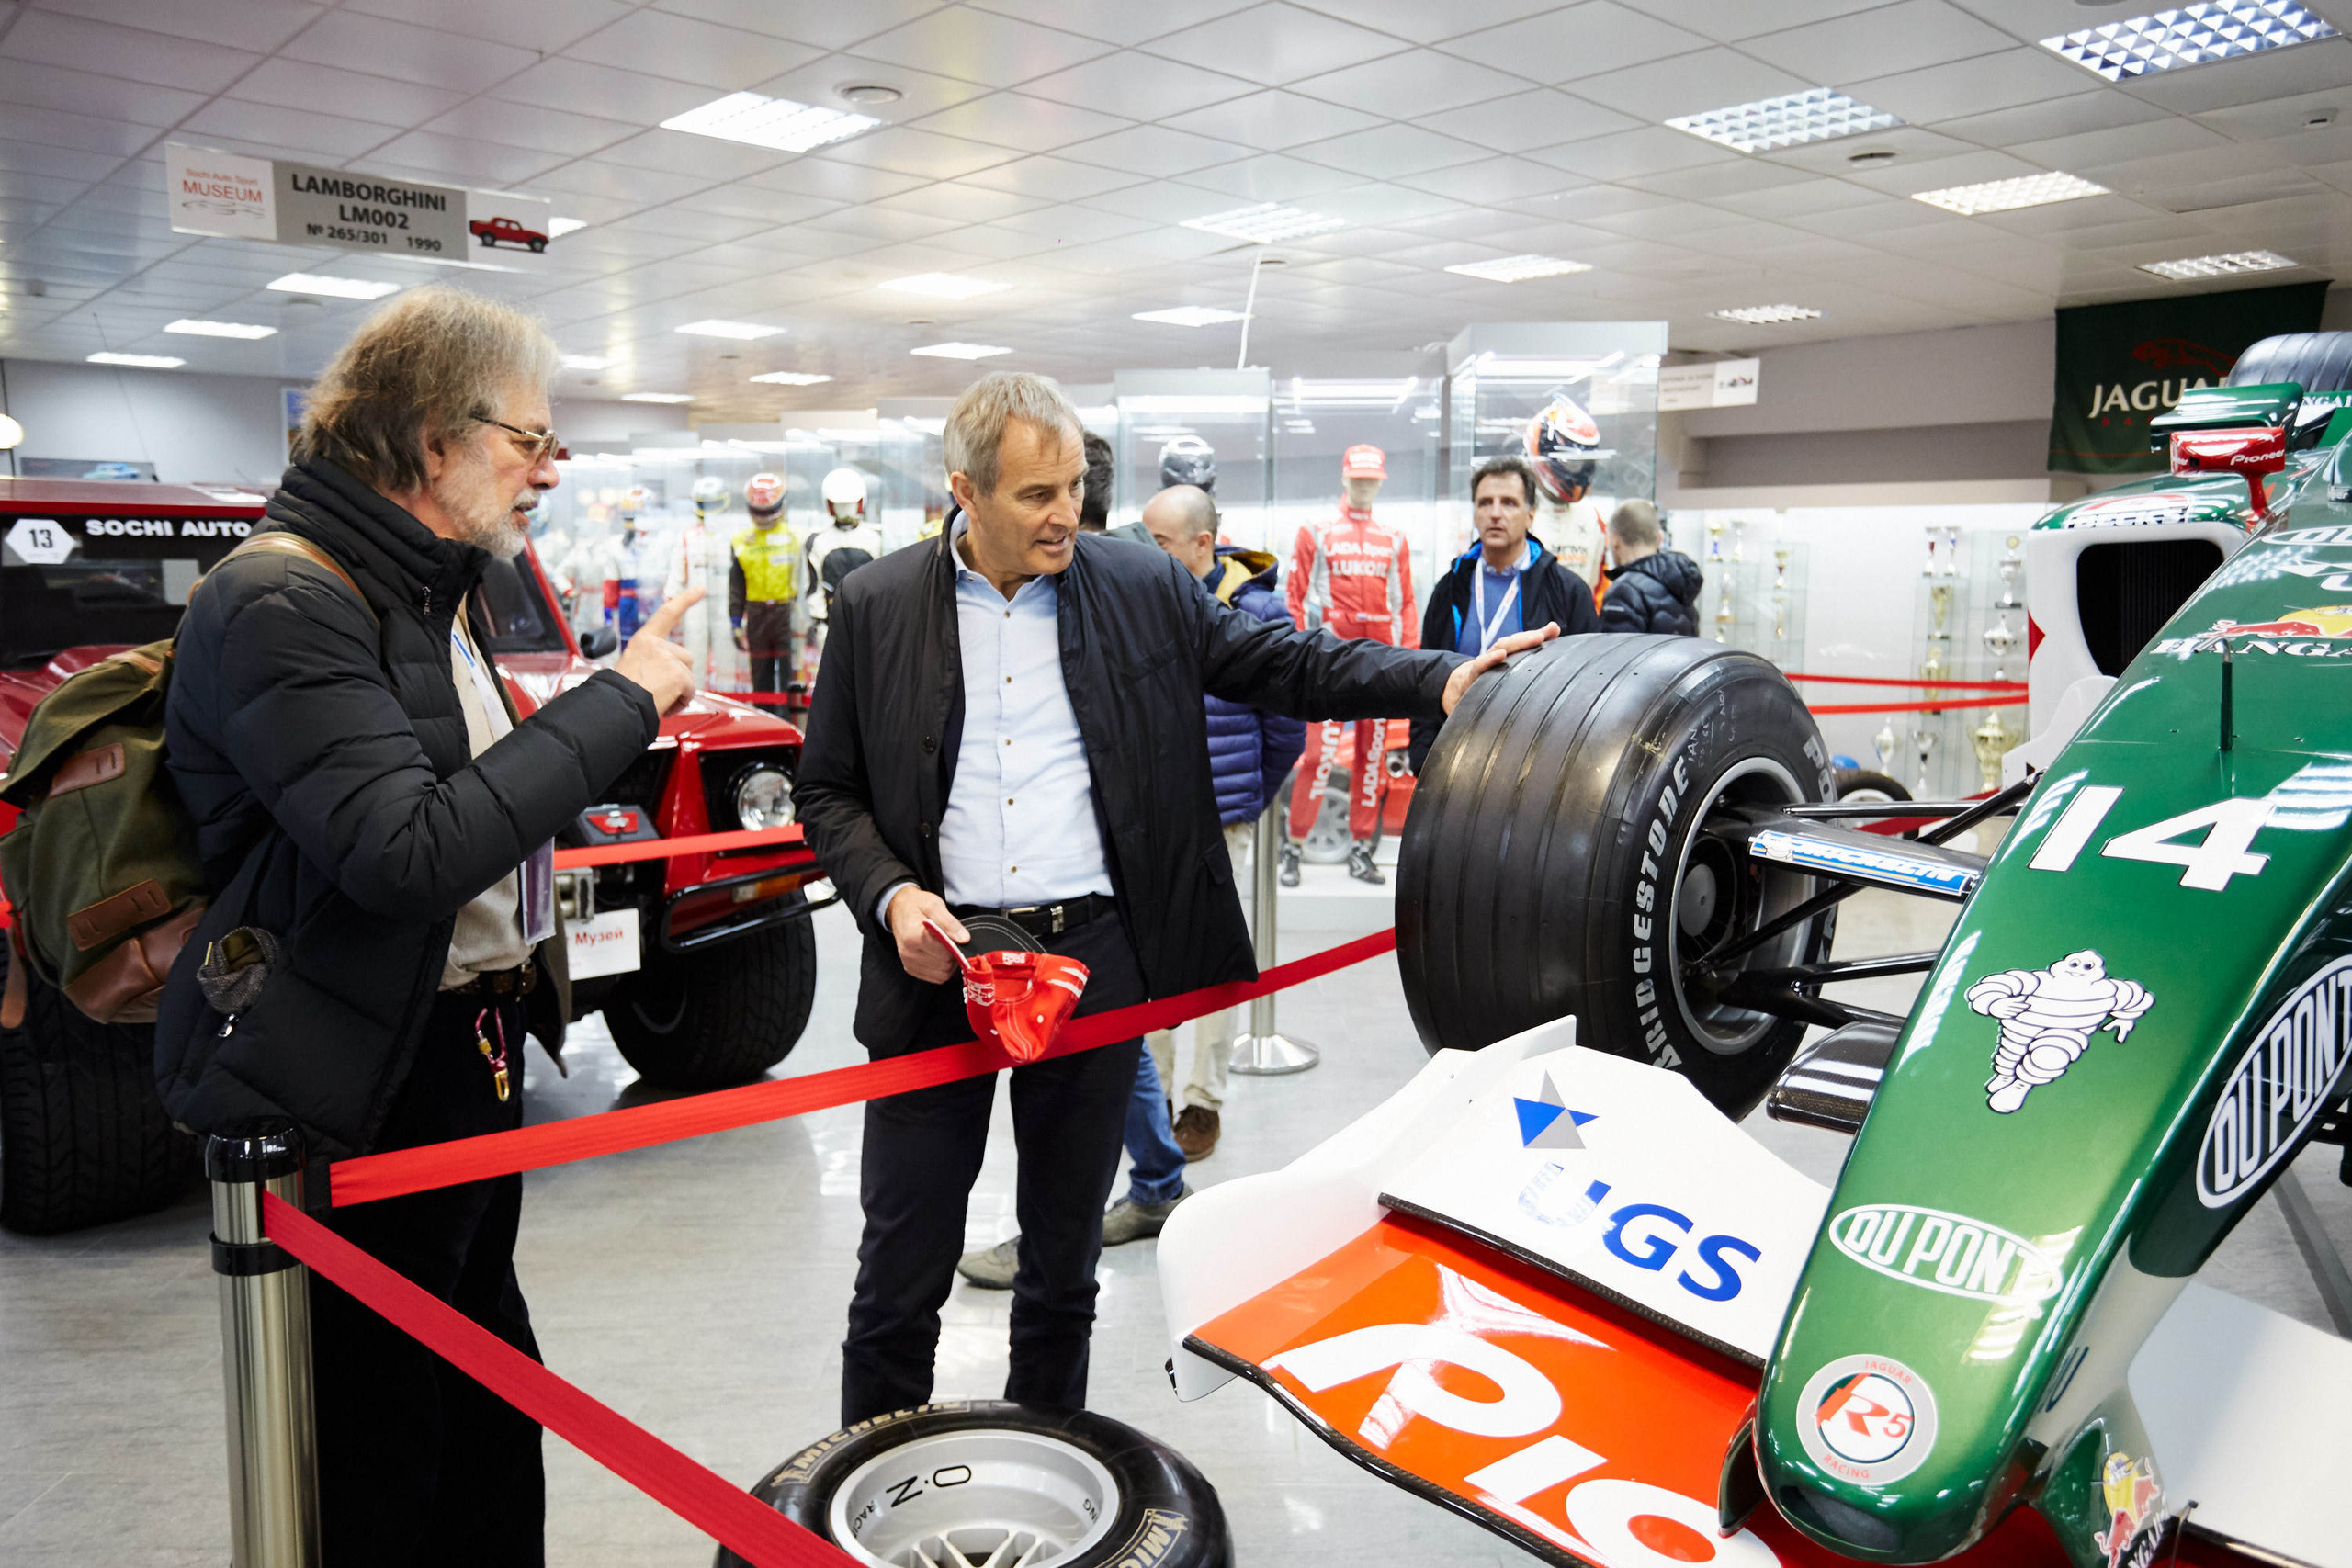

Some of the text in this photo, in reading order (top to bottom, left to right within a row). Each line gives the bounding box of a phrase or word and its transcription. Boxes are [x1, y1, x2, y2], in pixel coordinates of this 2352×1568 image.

[183, 179, 263, 203] MUSEUM
[291, 173, 447, 212] LAMBORGHINI
[338, 204, 411, 230] LM002
[327, 226, 388, 245] 265/301
[406, 236, 443, 253] 1990
[2088, 378, 2228, 419] JAGU
[2231, 449, 2285, 466] Pioneer
[28, 528, 54, 549] 13
[85, 518, 253, 538] SOCHI AUTO
[1324, 541, 1362, 557] LADA
[1332, 560, 1388, 577] LUKOIL
[2027, 785, 2270, 893] 14
[1633, 754, 1690, 1072] BRIDGESTONE
[574, 926, 624, 947] Музей
[2214, 1049, 2263, 1193] DU
[1518, 1161, 1762, 1303] UGS
[1842, 1210, 2052, 1297] DU PONT
[1863, 1360, 1913, 1384] JAGUAR
[1823, 1454, 1871, 1479] RACING
